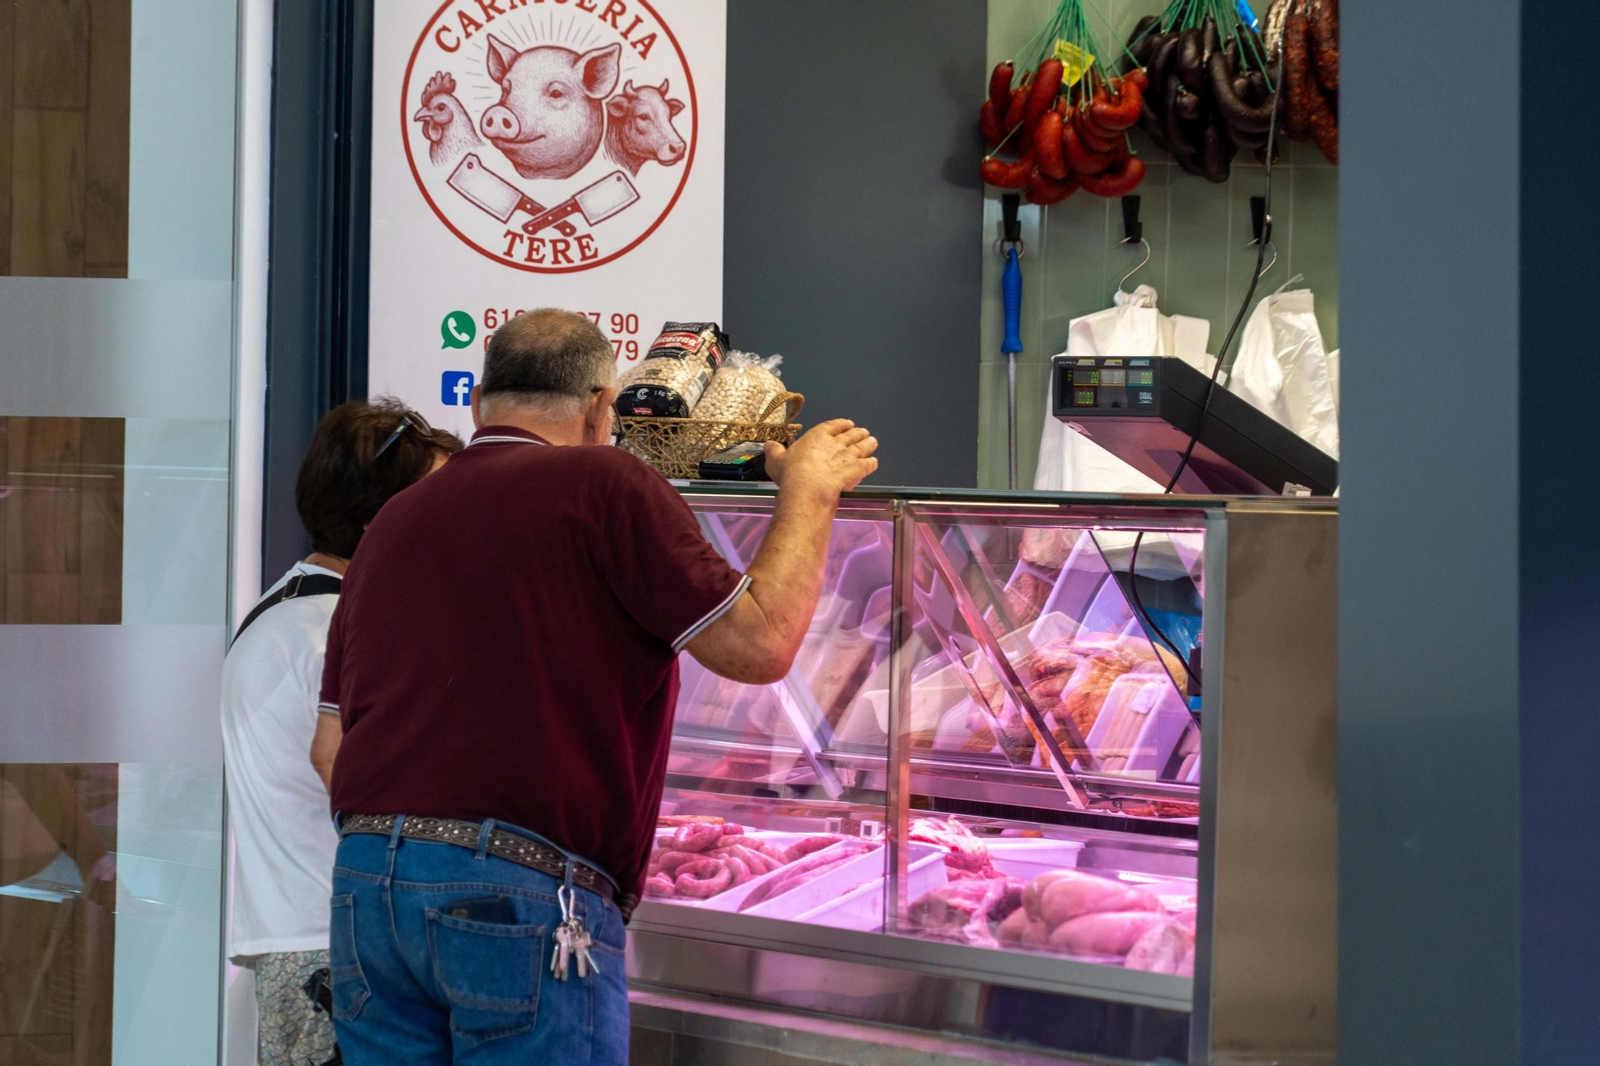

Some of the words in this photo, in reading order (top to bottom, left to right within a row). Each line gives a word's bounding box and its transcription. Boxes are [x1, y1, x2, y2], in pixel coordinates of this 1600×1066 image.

[434, 0, 658, 60] CARRIA
[502, 229, 599, 265] TERE
[484, 308, 527, 329] 61
[610, 313, 640, 335] 90
[611, 340, 639, 361] 79
